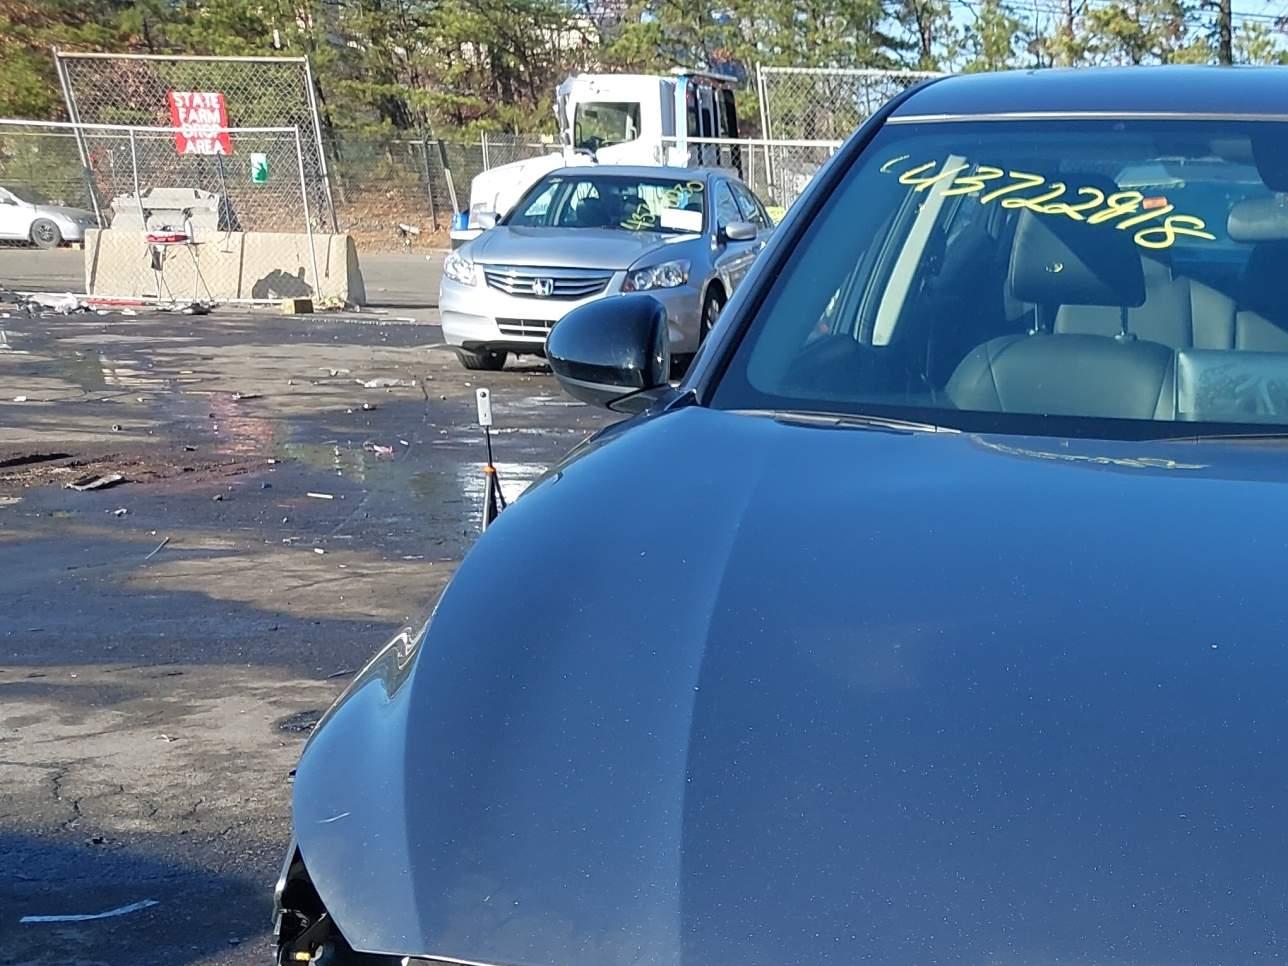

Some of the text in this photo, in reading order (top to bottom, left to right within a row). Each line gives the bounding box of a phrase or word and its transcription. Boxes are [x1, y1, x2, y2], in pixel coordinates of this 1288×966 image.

[172, 92, 220, 109] STATE
[178, 107, 221, 124] FARM
[184, 139, 226, 155] AREA
